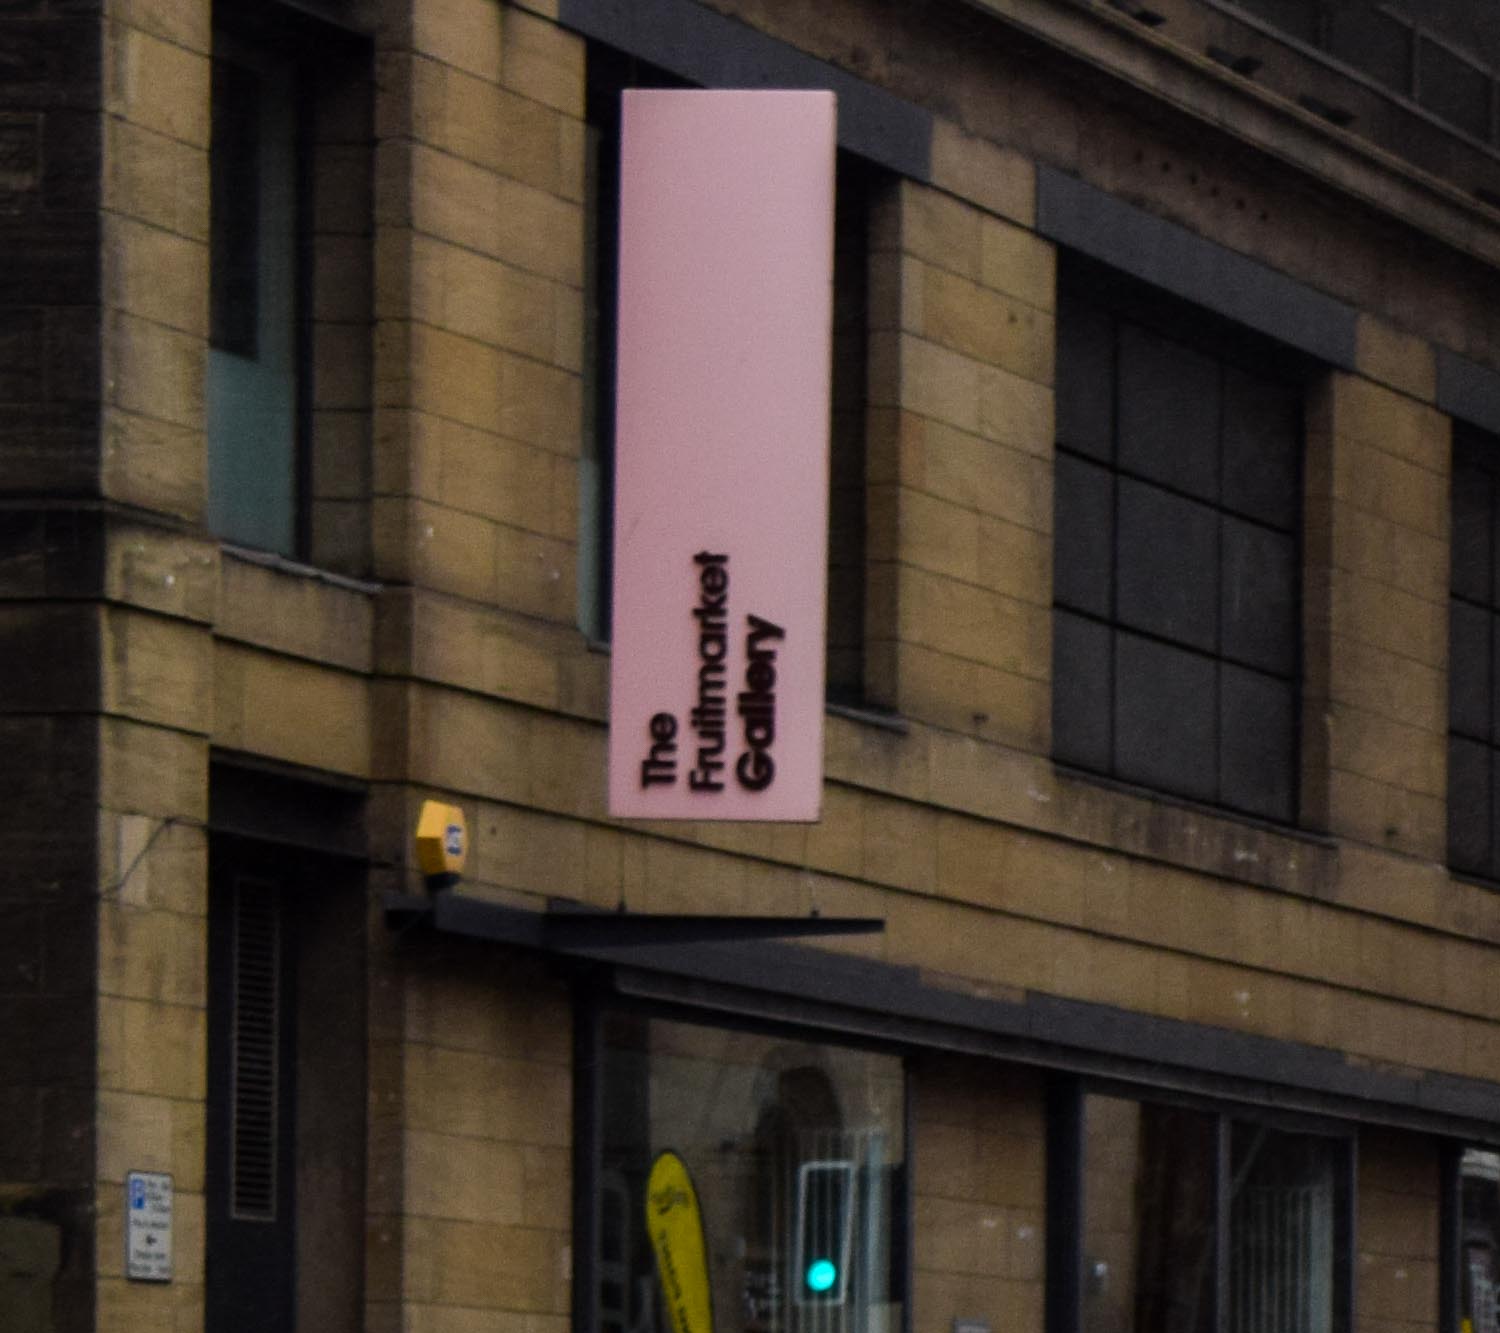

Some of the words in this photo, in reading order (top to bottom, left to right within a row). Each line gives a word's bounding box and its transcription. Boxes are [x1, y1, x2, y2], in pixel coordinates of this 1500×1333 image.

[641, 712, 677, 790] The
[689, 551, 730, 794] Fruitmarket
[736, 614, 787, 792] Gallery
